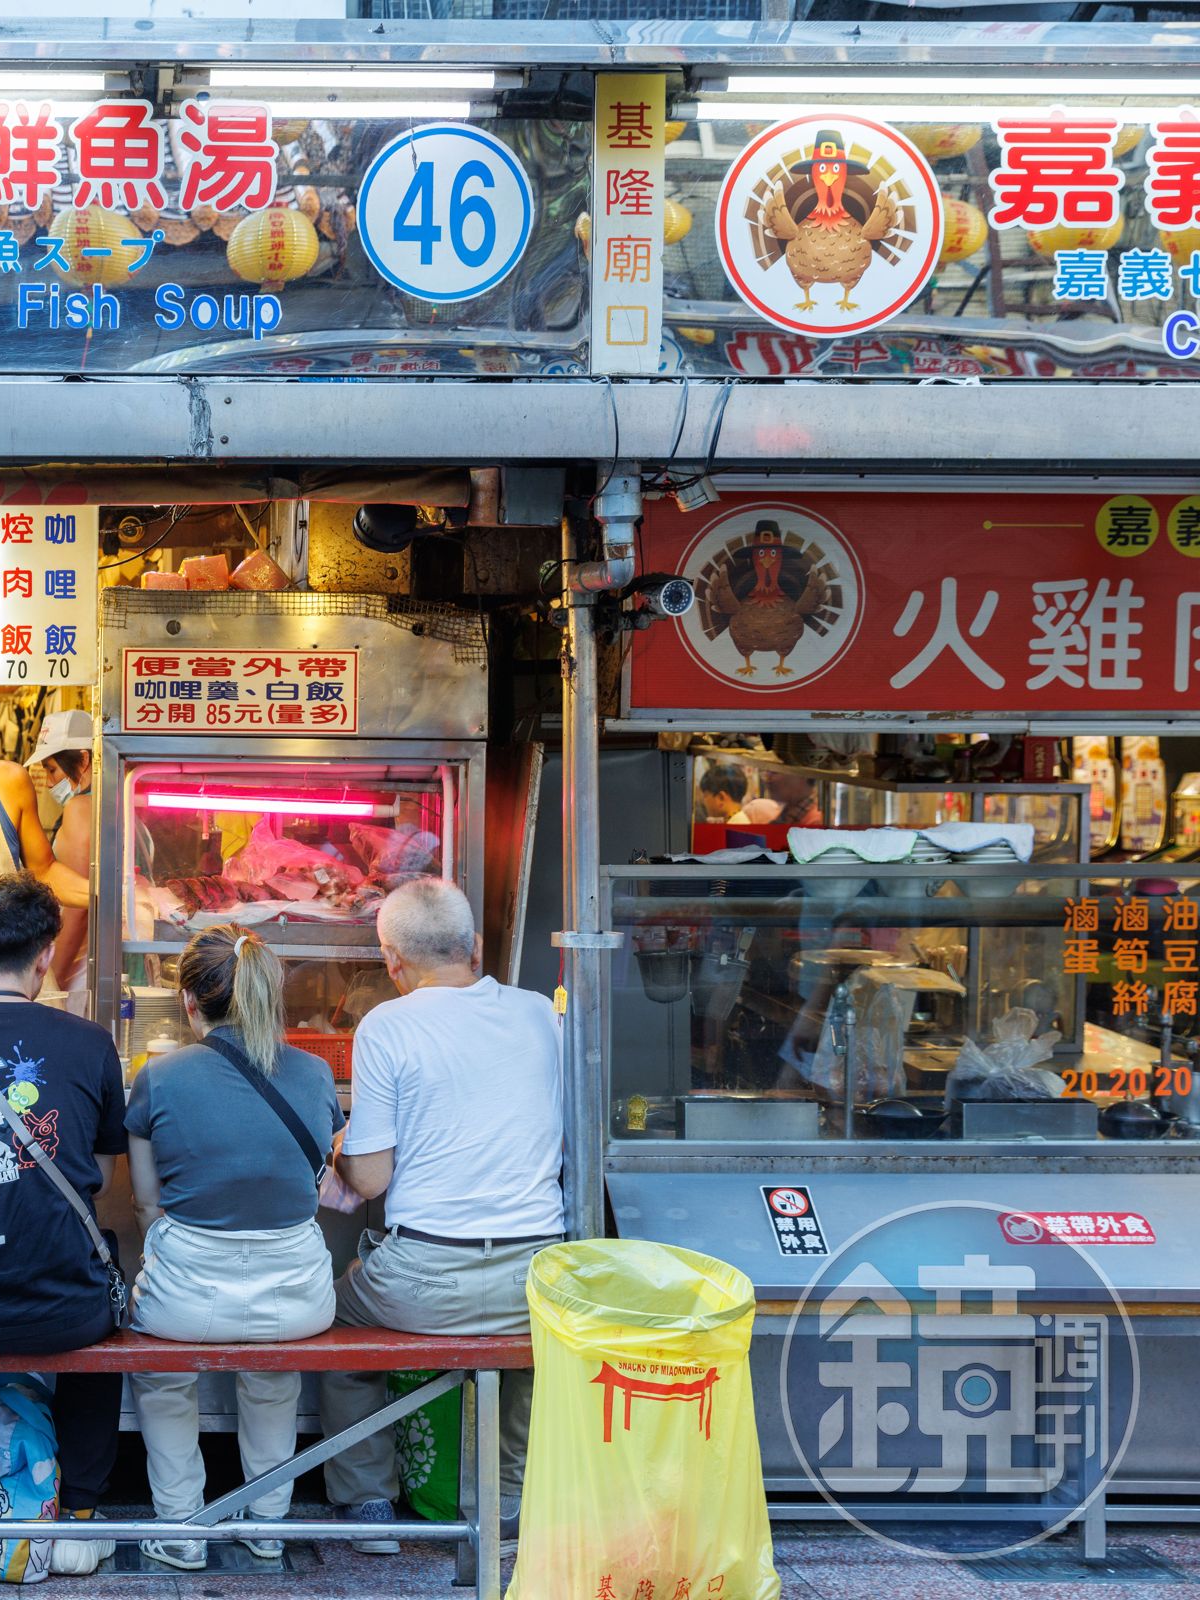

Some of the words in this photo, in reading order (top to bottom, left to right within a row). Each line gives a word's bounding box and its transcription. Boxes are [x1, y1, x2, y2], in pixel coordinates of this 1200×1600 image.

[393, 160, 497, 268] 46
[605, 101, 654, 346] 基隆廟口
[18, 283, 120, 329] Fish
[156, 283, 282, 340] Soup
[45, 513, 77, 655] 咖哩飯
[6, 660, 28, 679] 70
[48, 658, 70, 678] 70
[132, 656, 347, 677] 便當外帶
[1063, 897, 1099, 974] 滷蛋
[1161, 896, 1199, 1016] 油豆腐
[1061, 1068, 1098, 1098] 20
[1109, 1068, 1147, 1097] 20
[1154, 1066, 1193, 1096] 20
[775, 1217, 817, 1231] 禁用
[1043, 1215, 1149, 1234] 禁帶外食
[781, 1234, 822, 1248] 外食
